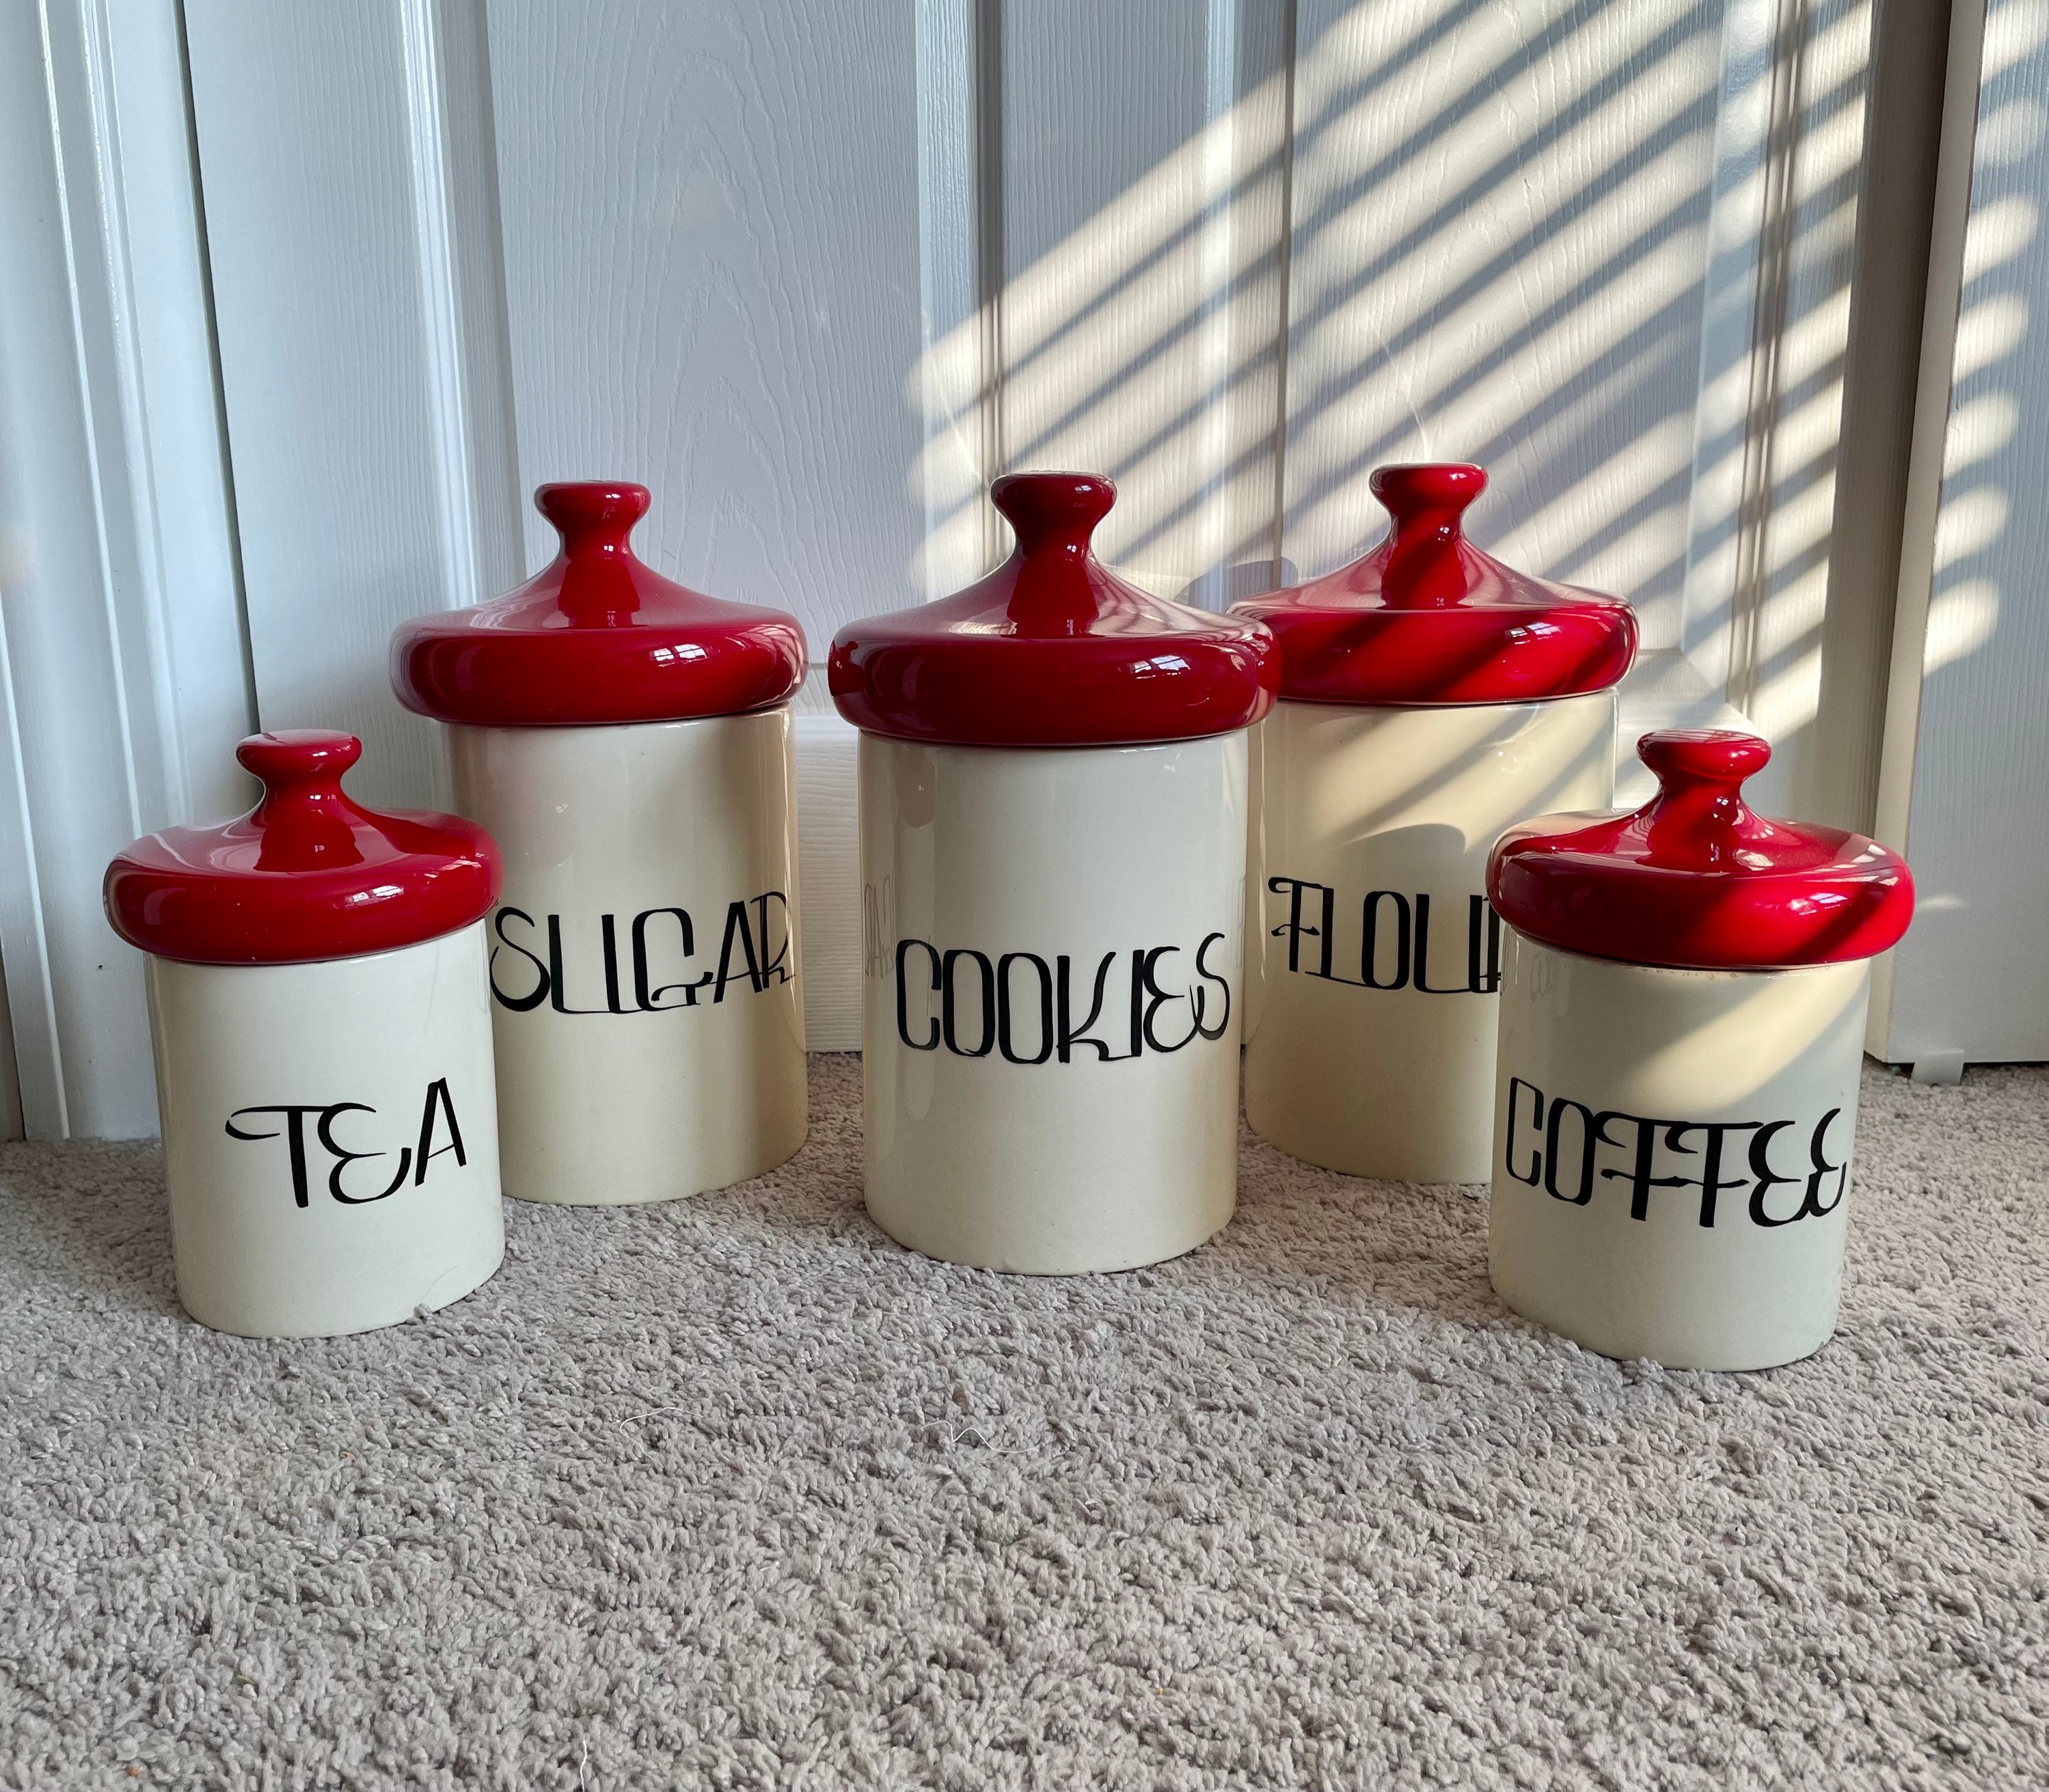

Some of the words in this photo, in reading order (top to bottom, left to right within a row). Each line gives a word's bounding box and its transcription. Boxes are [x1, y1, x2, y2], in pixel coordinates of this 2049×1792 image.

[490, 891, 796, 1014] SUGAR
[896, 932, 1230, 1064] COOKIES
[225, 1077, 467, 1208] TEA
[1505, 1077, 1847, 1228] COFFEE
